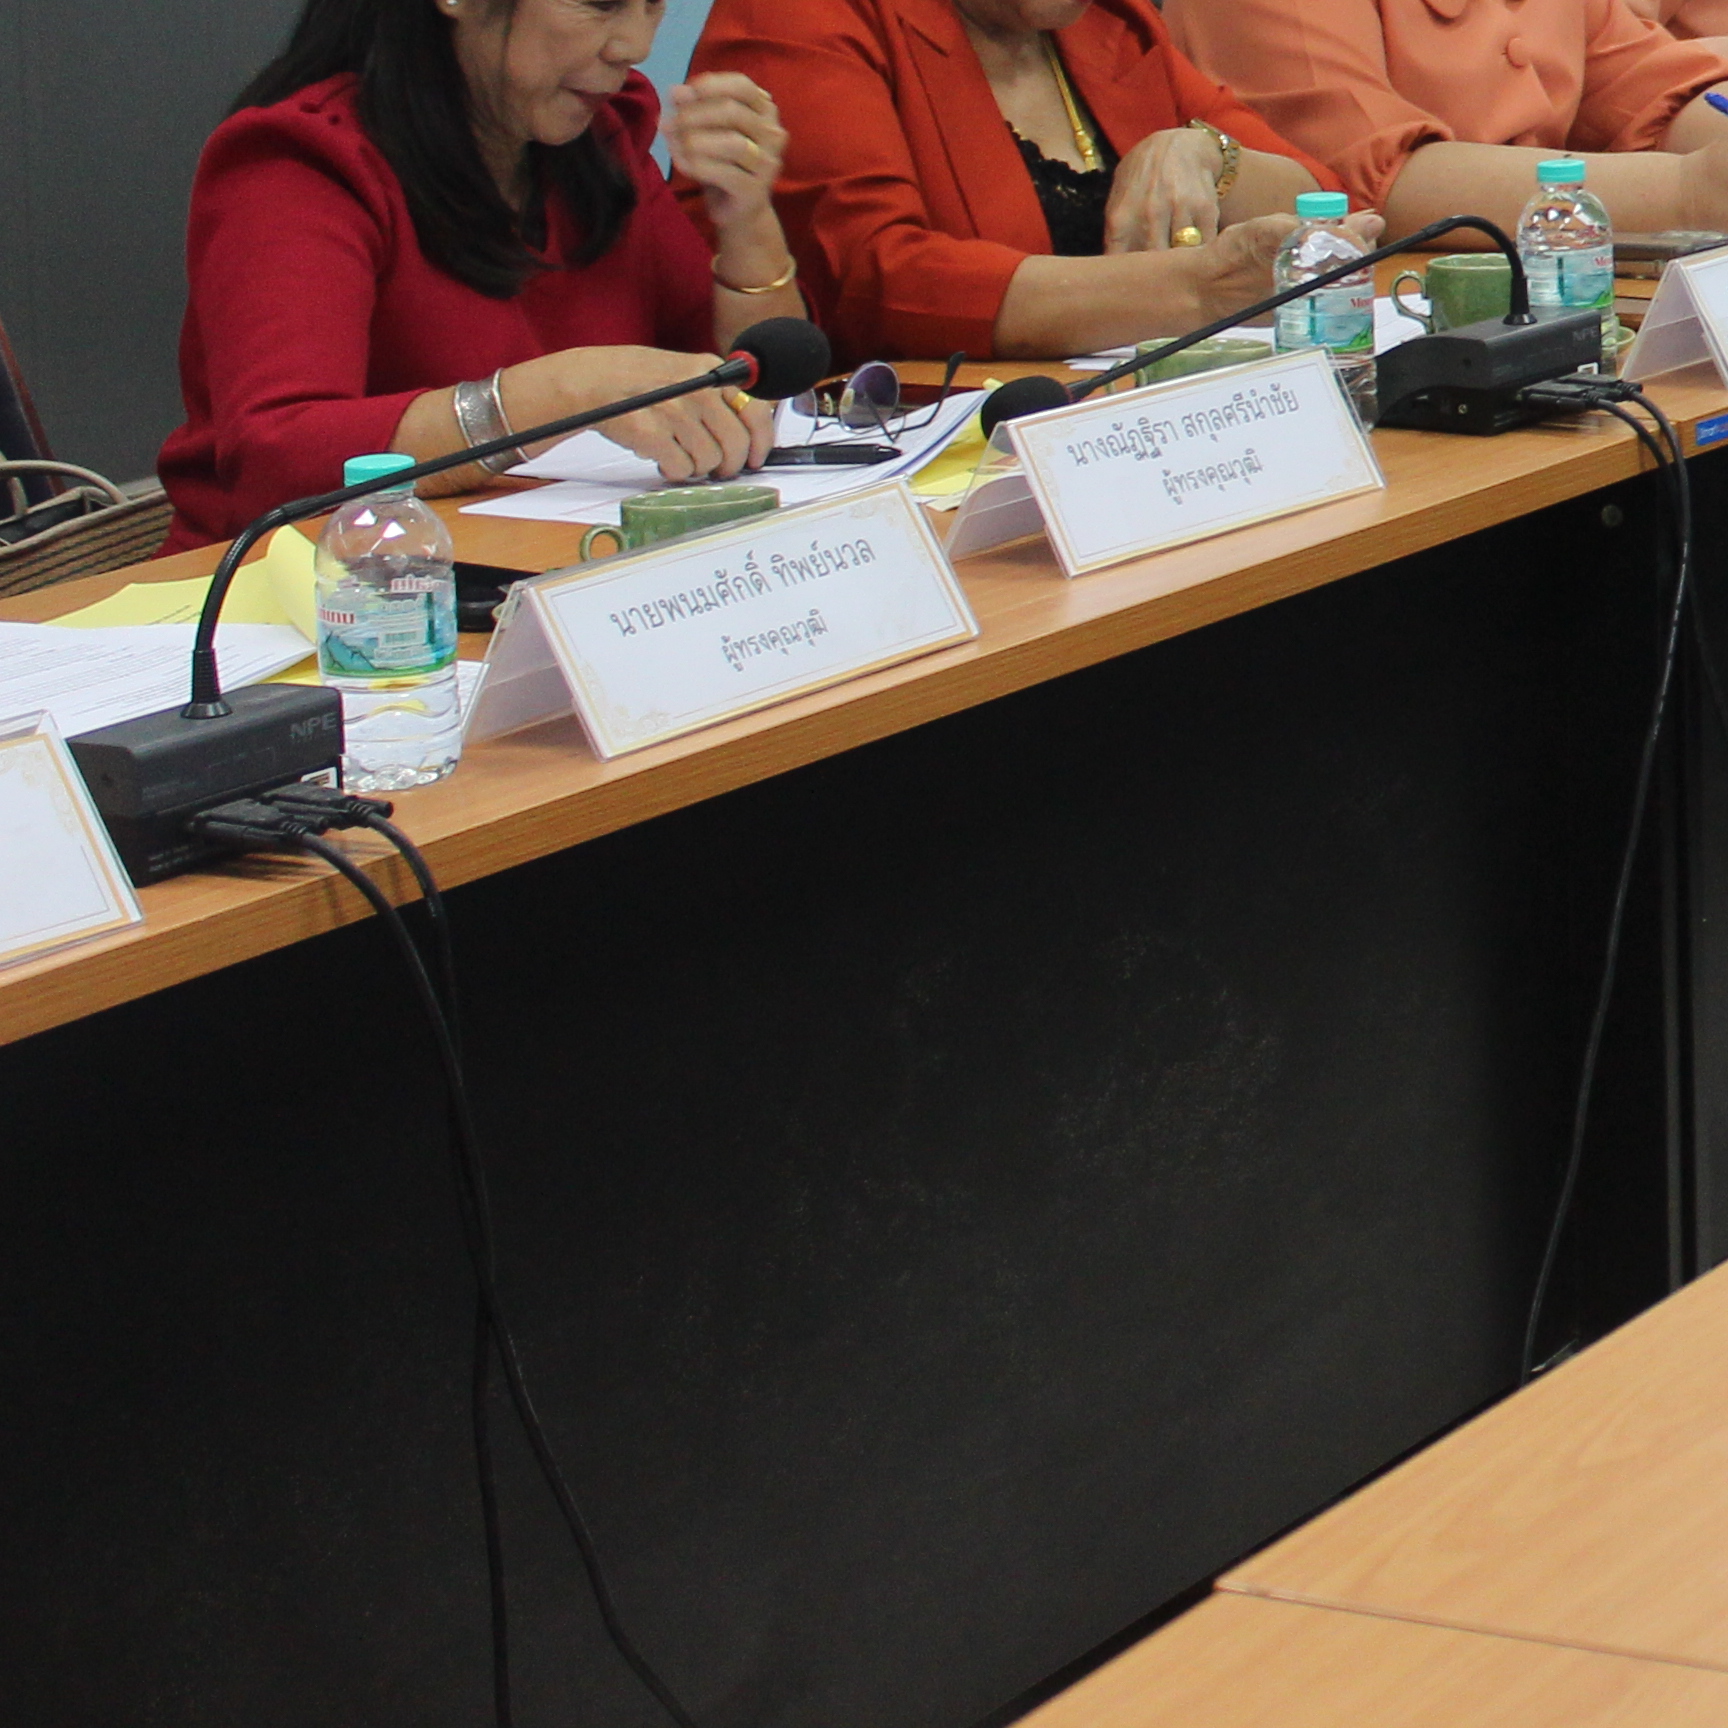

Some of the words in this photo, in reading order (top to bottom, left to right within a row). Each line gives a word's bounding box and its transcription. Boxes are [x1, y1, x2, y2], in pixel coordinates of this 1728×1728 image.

[1181, 382, 1300, 443] สกุลศรีนำชัย
[1161, 447, 1264, 505] ผู้ทรงคุณวุฒิ
[610, 549, 773, 638] นายพนมศักดิ์
[771, 536, 877, 588] ทิพย์นวล
[720, 608, 829, 672] ผู้ทรงคุณวุฒิ
